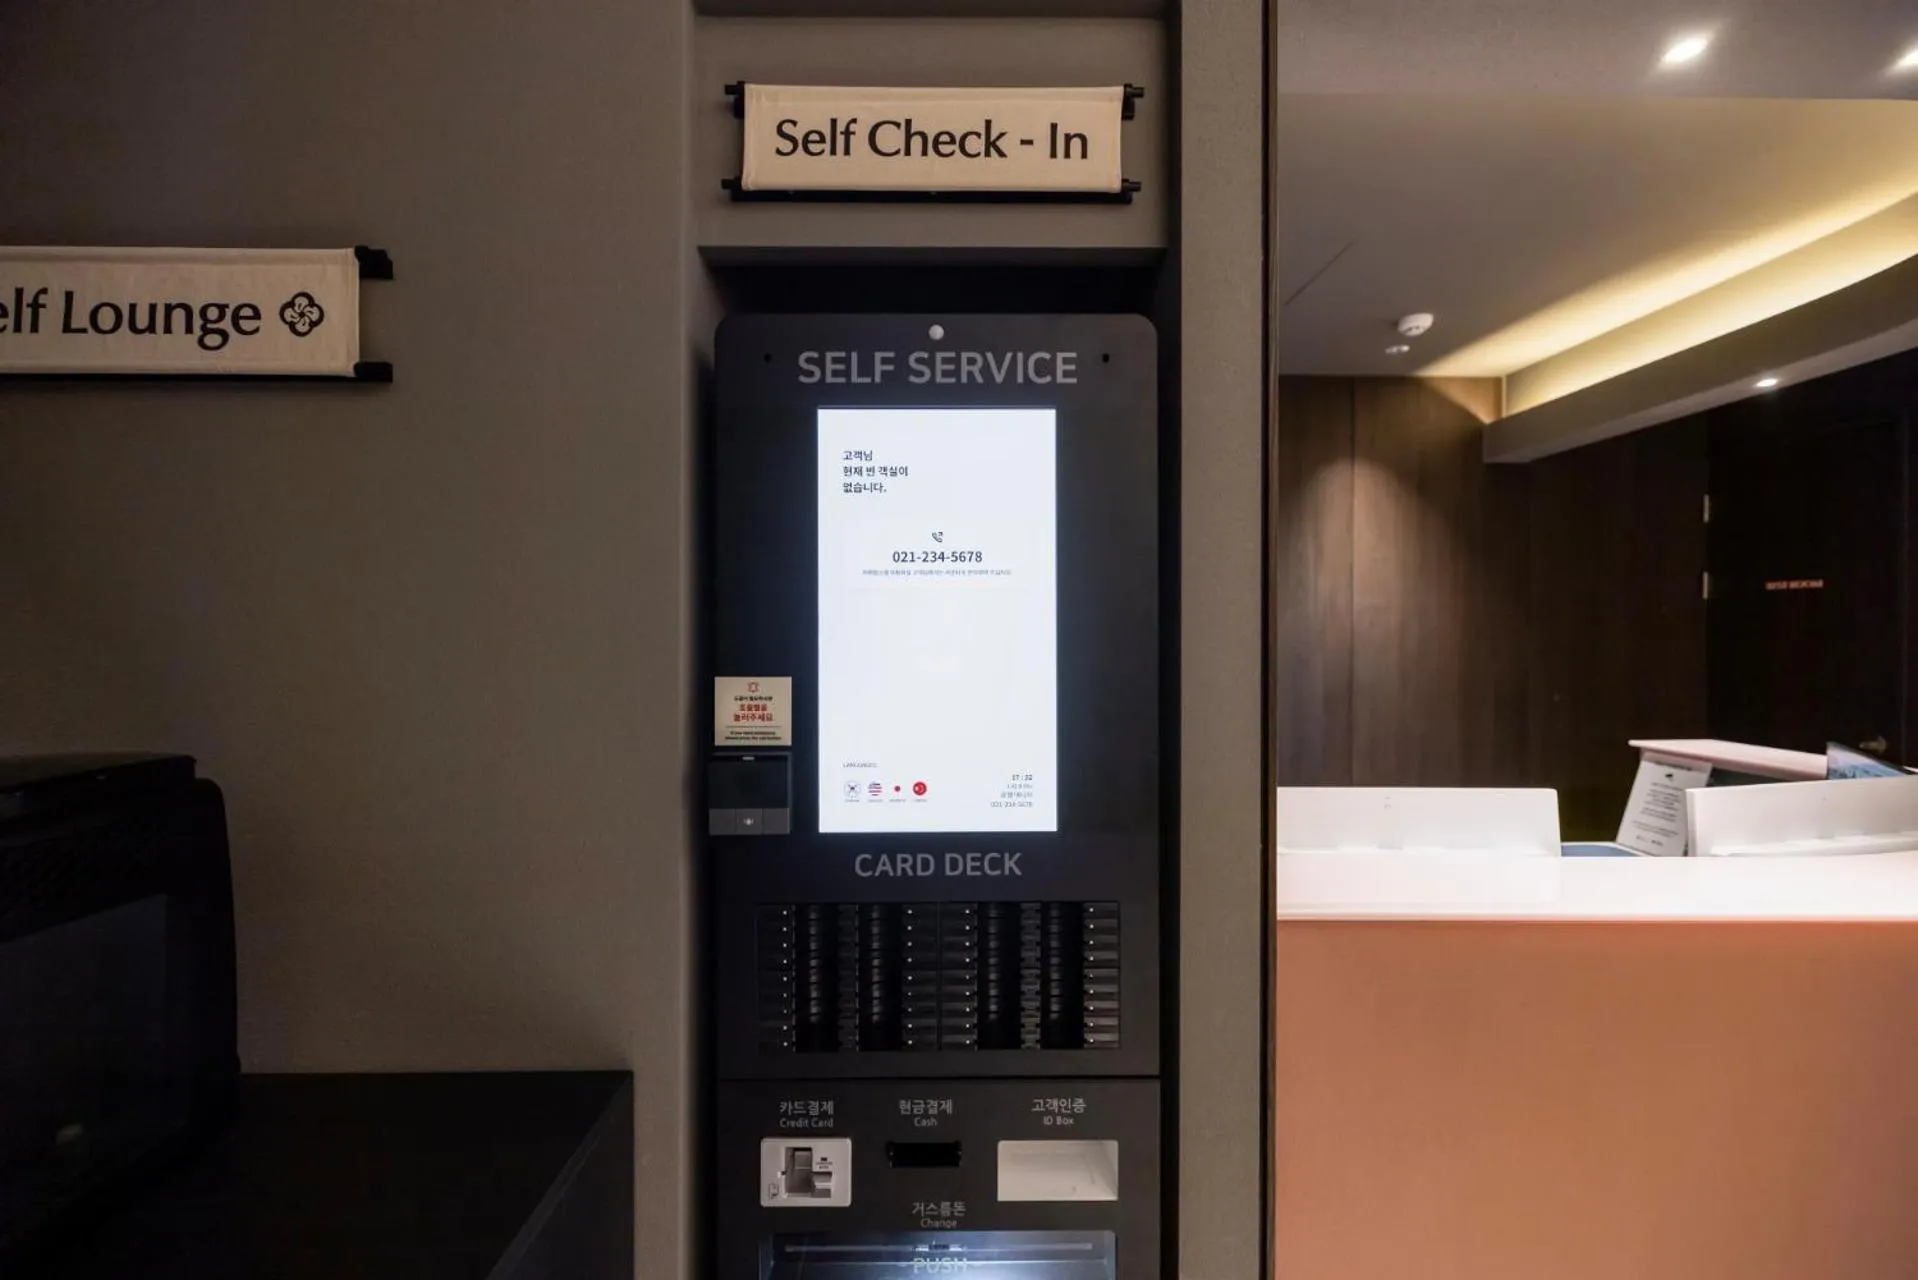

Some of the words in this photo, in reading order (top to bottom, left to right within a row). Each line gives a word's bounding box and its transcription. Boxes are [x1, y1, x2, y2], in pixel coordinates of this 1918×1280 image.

[775, 118, 858, 157] Self
[868, 119, 1008, 159] Check
[1049, 122, 1089, 159] In
[0, 286, 49, 334] lf
[62, 290, 262, 351] Lounge
[797, 350, 895, 385] SELF
[907, 351, 1079, 385] SERVICE
[842, 450, 873, 461] 고객님
[843, 465, 863, 477] 현재
[843, 482, 887, 493] 없습니다.
[892, 551, 983, 563] 021-234-5678
[854, 853, 935, 877] CARD
[944, 852, 1023, 876] DECK
[899, 1099, 953, 1115] 현금결제
[1031, 1097, 1087, 1113] 고객인증
[779, 1117, 808, 1128] Credit
[811, 1117, 834, 1128] Card
[913, 1116, 938, 1127] Cash
[1043, 1115, 1054, 1125] ID
[1056, 1115, 1074, 1125] Box
[911, 1201, 967, 1217] 거스름돈
[920, 1217, 957, 1229] Change
[913, 1257, 968, 1274] PUSH
